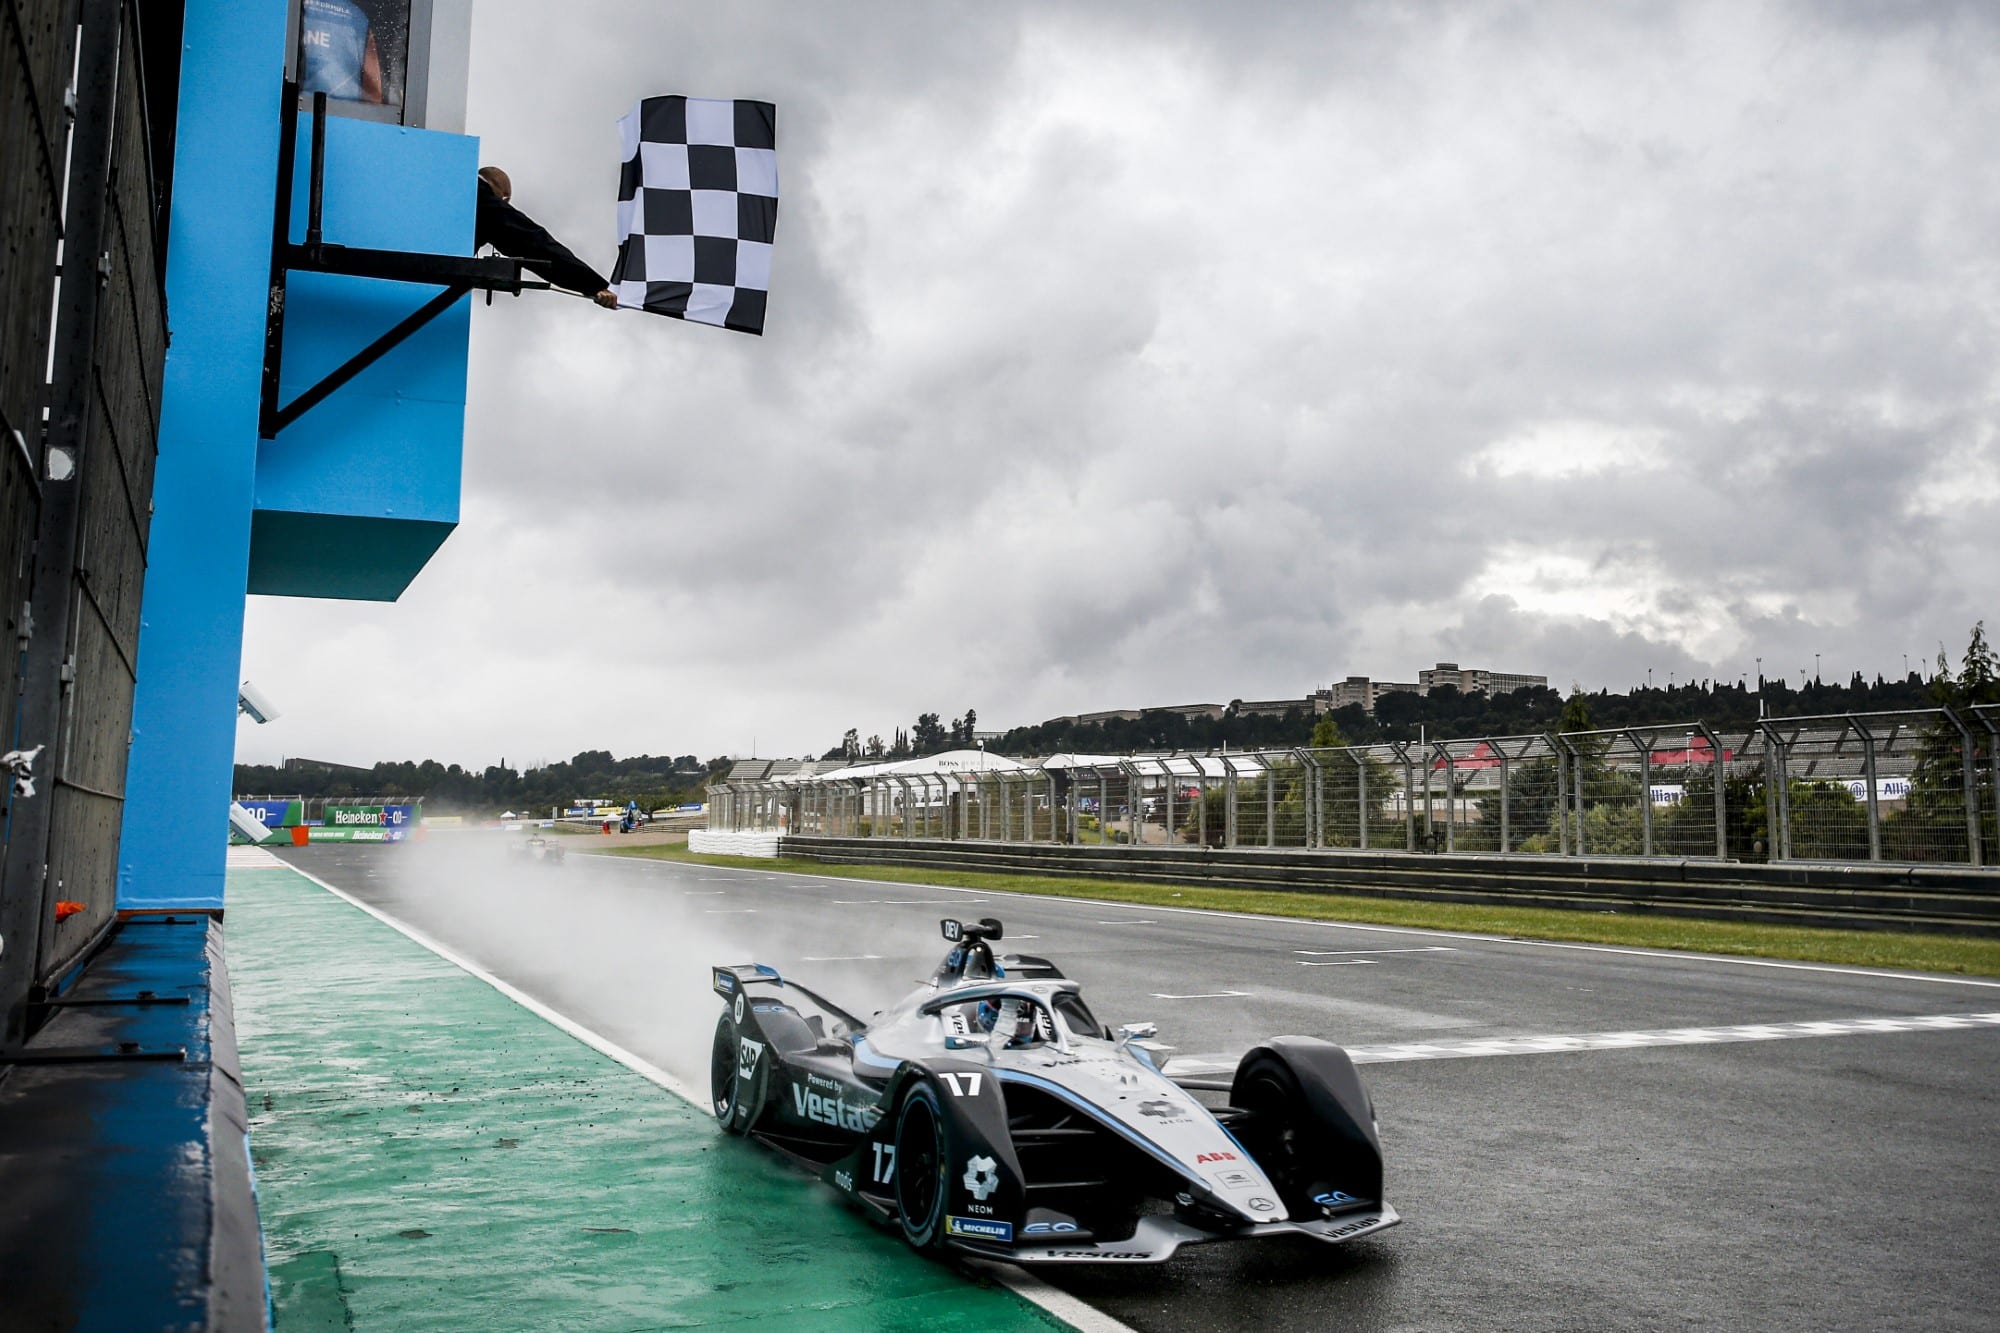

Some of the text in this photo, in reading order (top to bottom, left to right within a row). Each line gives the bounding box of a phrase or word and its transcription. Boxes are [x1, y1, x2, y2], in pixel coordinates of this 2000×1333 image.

[304, 30, 330, 48] NE
[1884, 782, 1910, 795] Allia
[335, 810, 378, 824] Heineken
[945, 921, 959, 938] DEV
[740, 1045, 757, 1072] SAP
[807, 1072, 843, 1094] Powered by
[938, 1072, 983, 1096] 17
[872, 1141, 896, 1184] 17
[1196, 1151, 1237, 1164] ABB
[967, 1204, 993, 1215] NEOM
[962, 1224, 1007, 1236] MICHELIN
[1322, 1217, 1381, 1238] Vestas
[1046, 1250, 1153, 1260] Vestas
